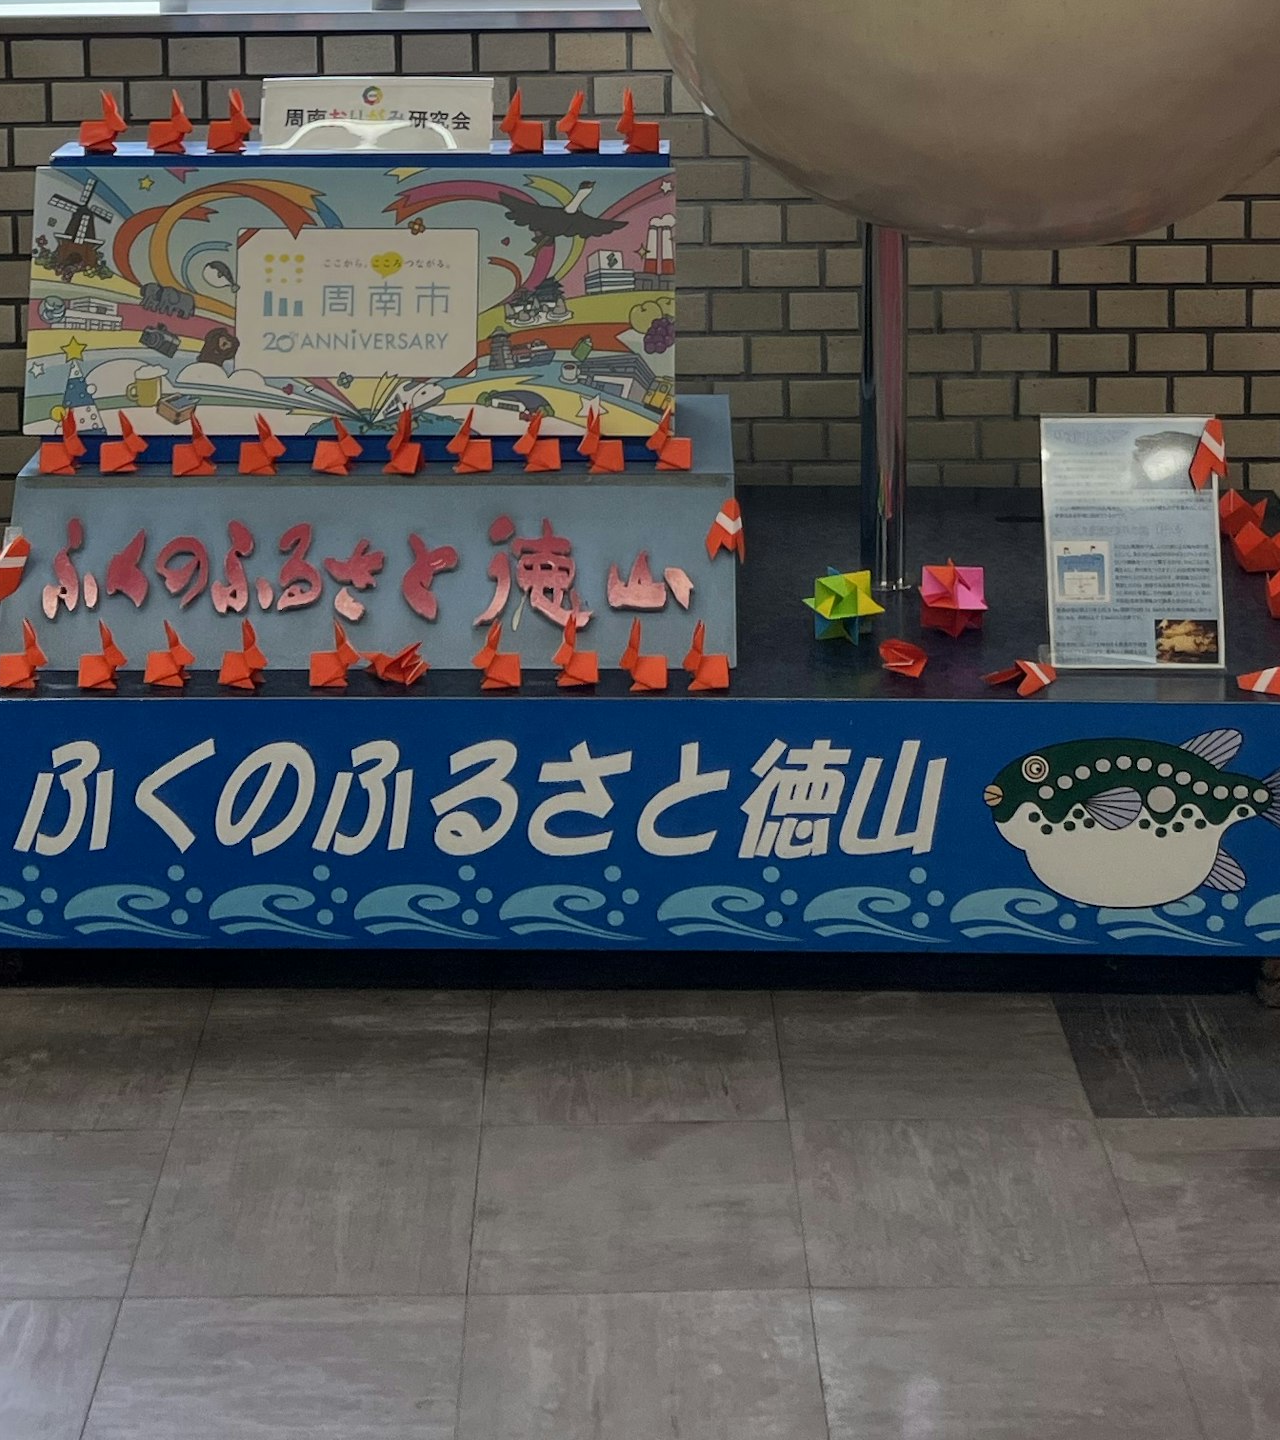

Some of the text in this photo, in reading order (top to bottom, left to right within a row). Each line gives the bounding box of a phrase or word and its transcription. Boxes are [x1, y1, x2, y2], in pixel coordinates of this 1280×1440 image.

[321, 281, 451, 317] 周南市
[42, 513, 695, 630] ふくのふるさと徳山
[13, 737, 948, 860] ふくのふるさと徳山
